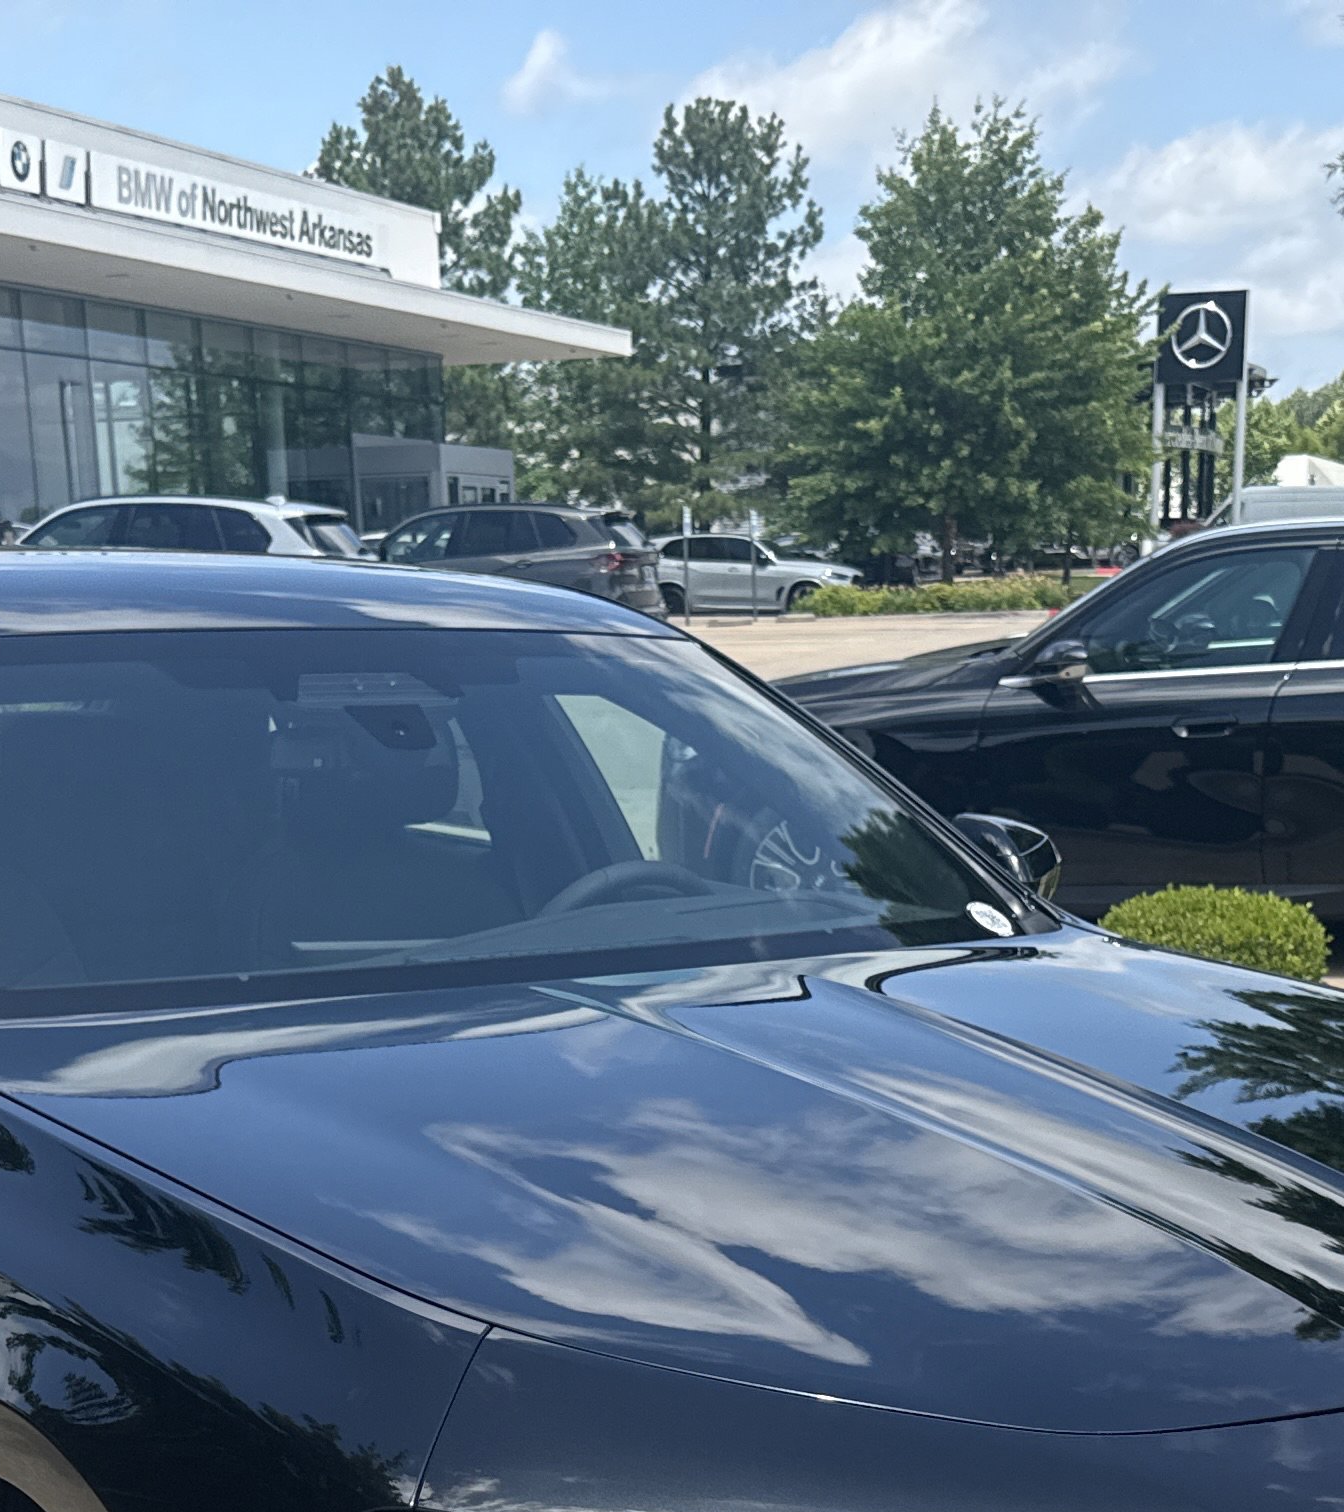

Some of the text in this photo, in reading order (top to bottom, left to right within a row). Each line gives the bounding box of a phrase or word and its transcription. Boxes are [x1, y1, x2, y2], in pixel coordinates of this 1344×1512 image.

[118, 165, 373, 258] BMW of Northwest Arkansas
